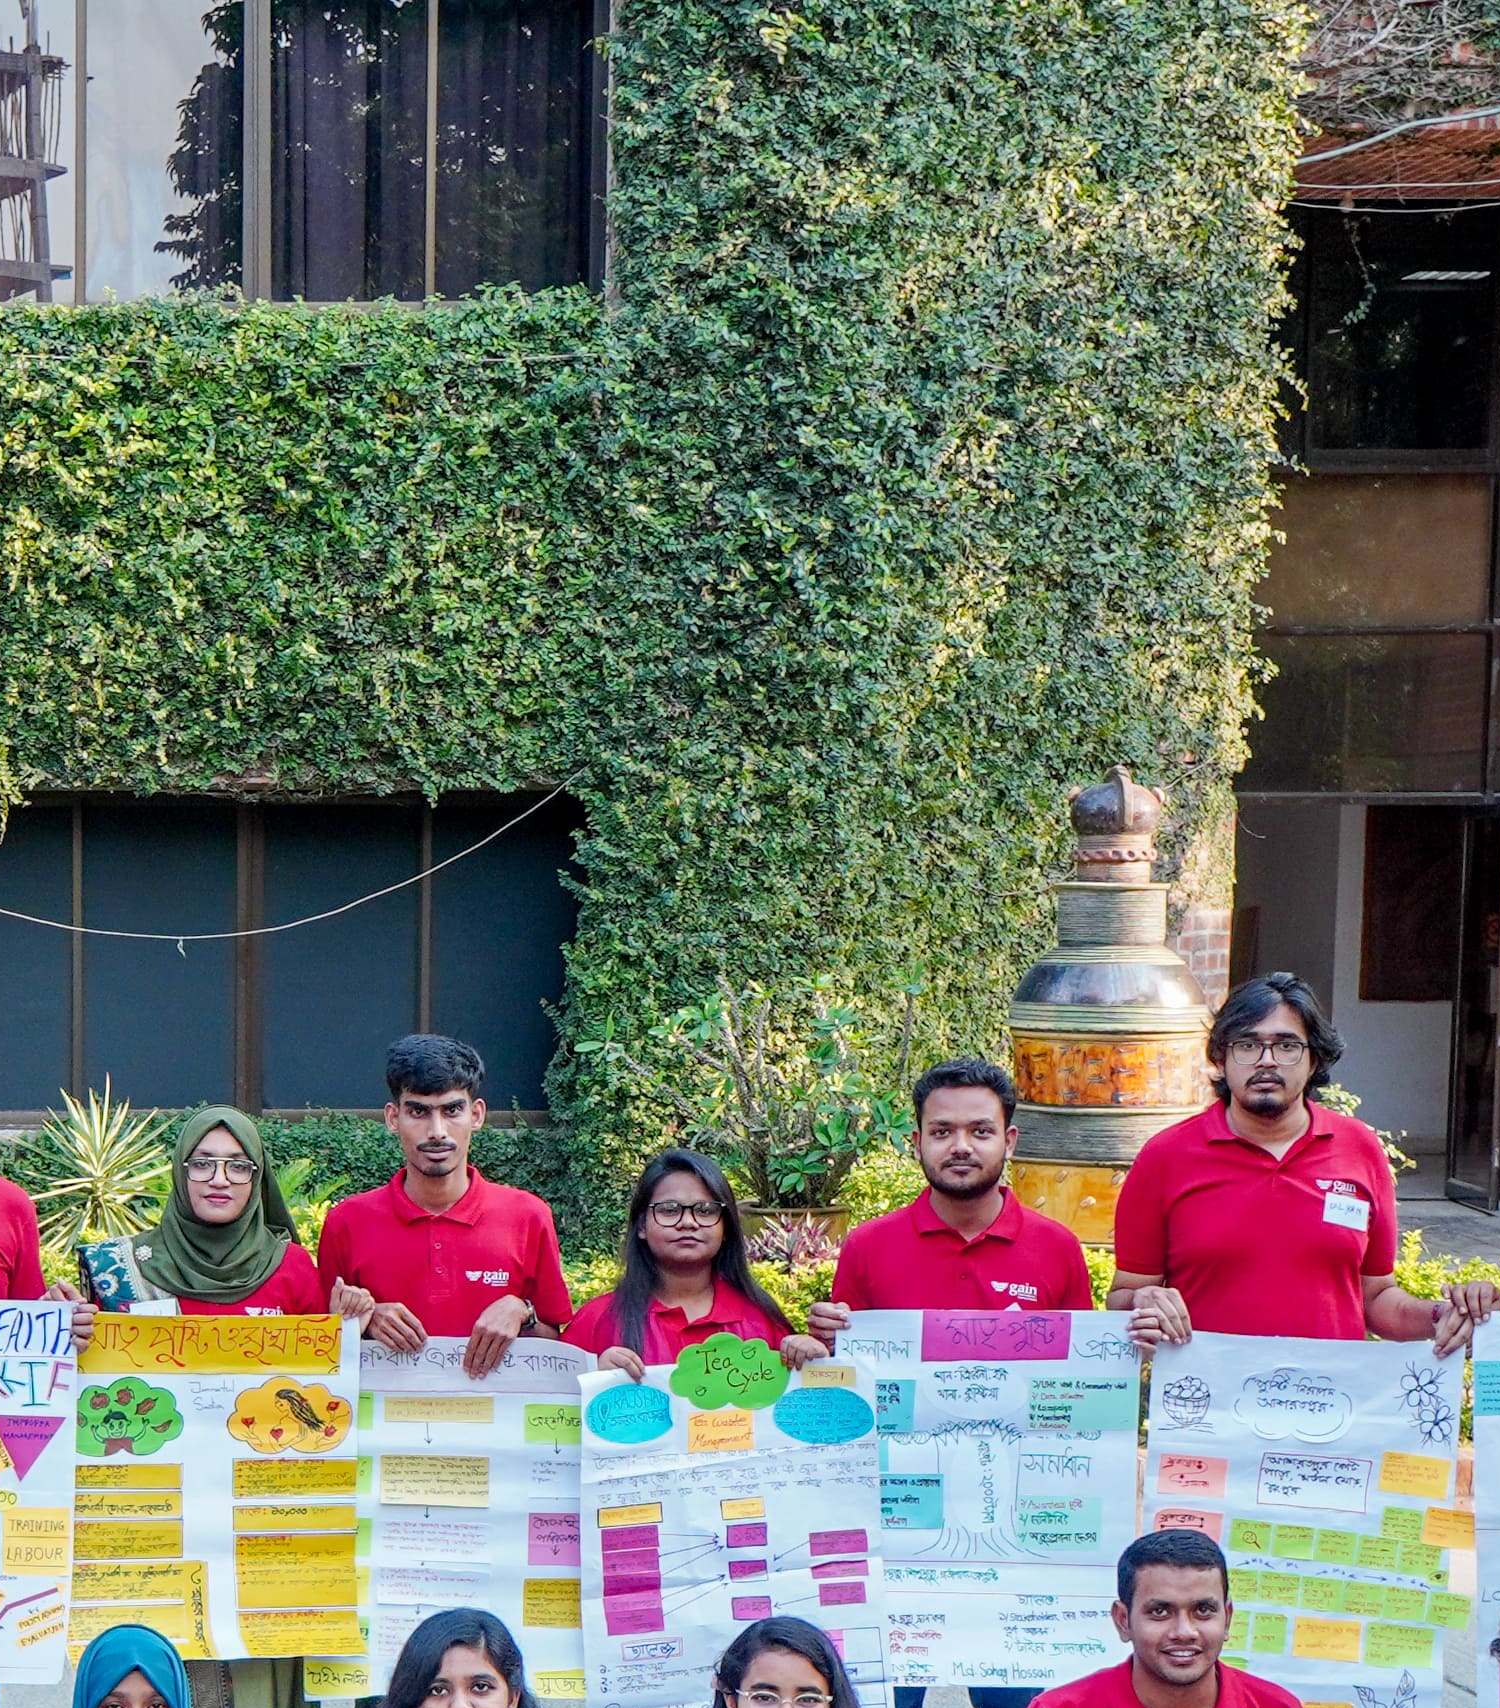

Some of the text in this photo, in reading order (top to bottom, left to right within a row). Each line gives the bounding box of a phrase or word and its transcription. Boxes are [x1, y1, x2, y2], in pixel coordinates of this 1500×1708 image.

[1333, 1180, 1356, 1196] gain
[483, 1268, 510, 1284] gain
[1010, 1283, 1038, 1298] gain
[695, 1347, 732, 1375] Tea
[726, 1361, 776, 1396] Cycle
[9, 1516, 65, 1533] TRAINING
[6, 1545, 65, 1563] LABOUR
